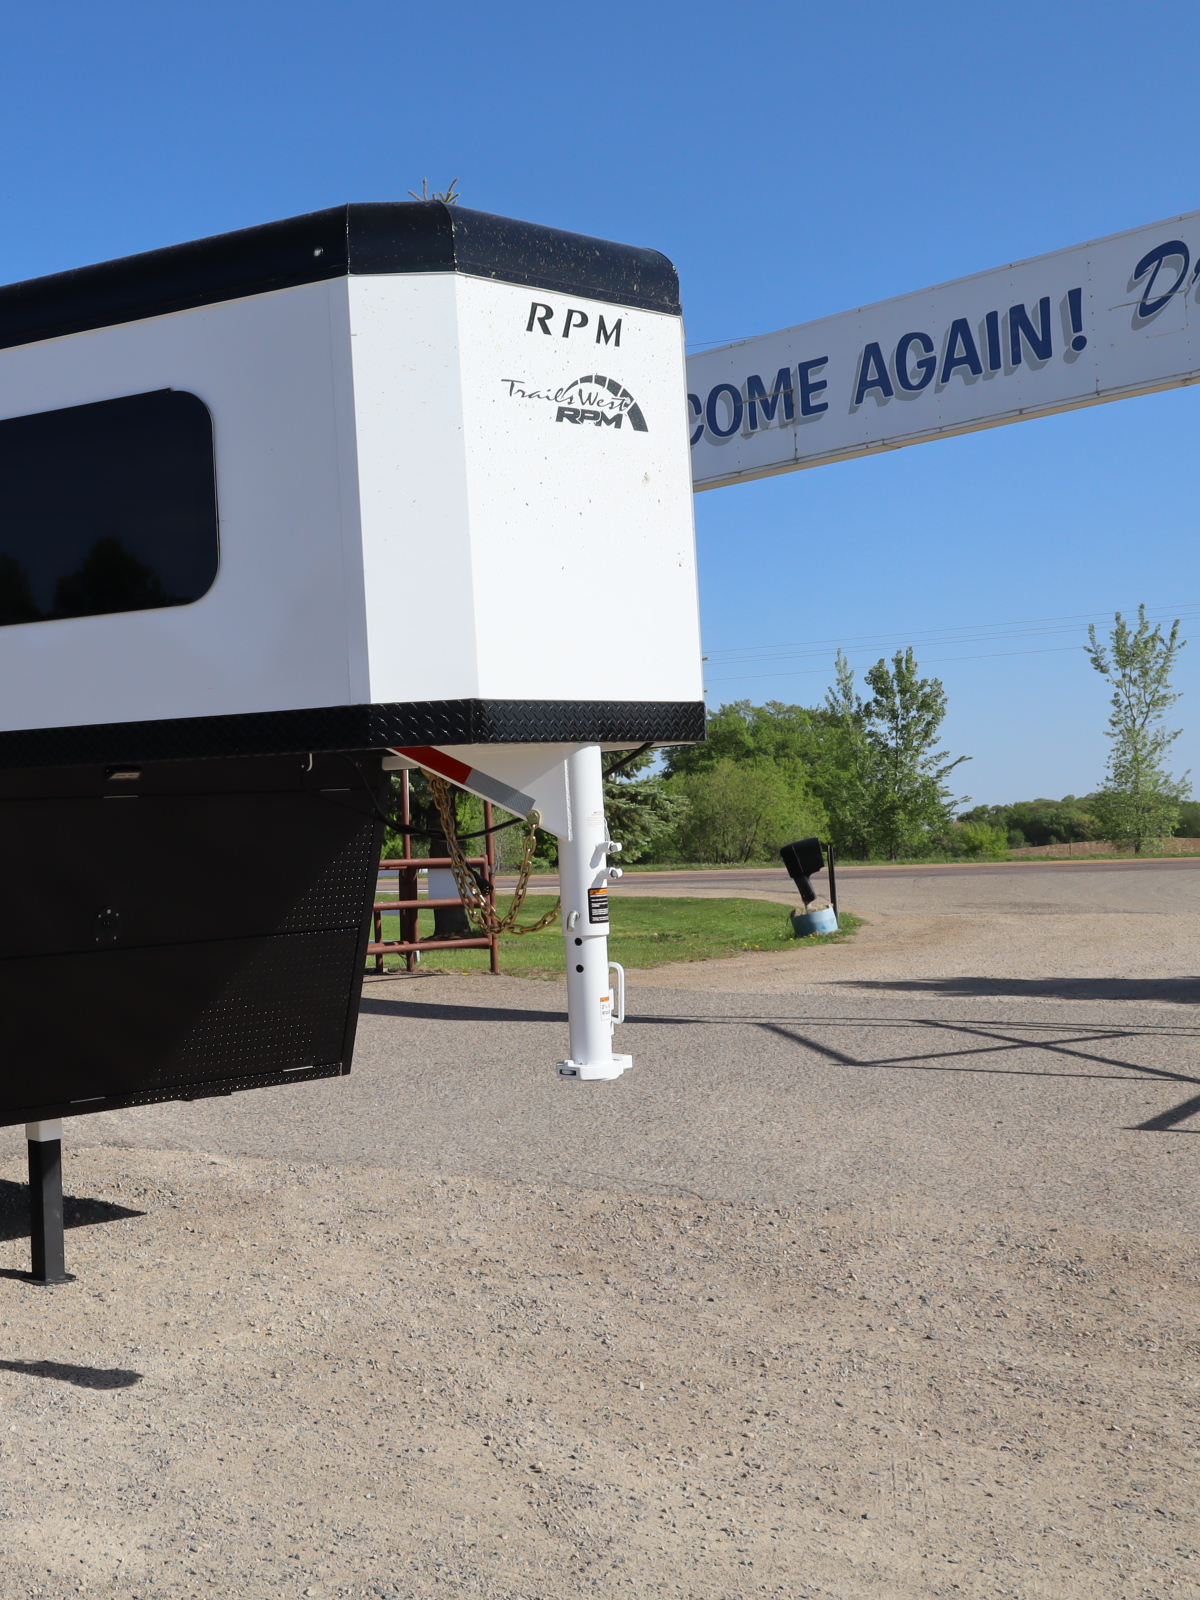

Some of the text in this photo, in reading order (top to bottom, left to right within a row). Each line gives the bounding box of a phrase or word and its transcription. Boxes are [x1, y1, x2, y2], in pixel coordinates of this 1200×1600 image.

[526, 302, 622, 347] RPM
[853, 287, 1088, 405] AGAIN!
[1133, 240, 1200, 318] D
[555, 406, 623, 429] RPM
